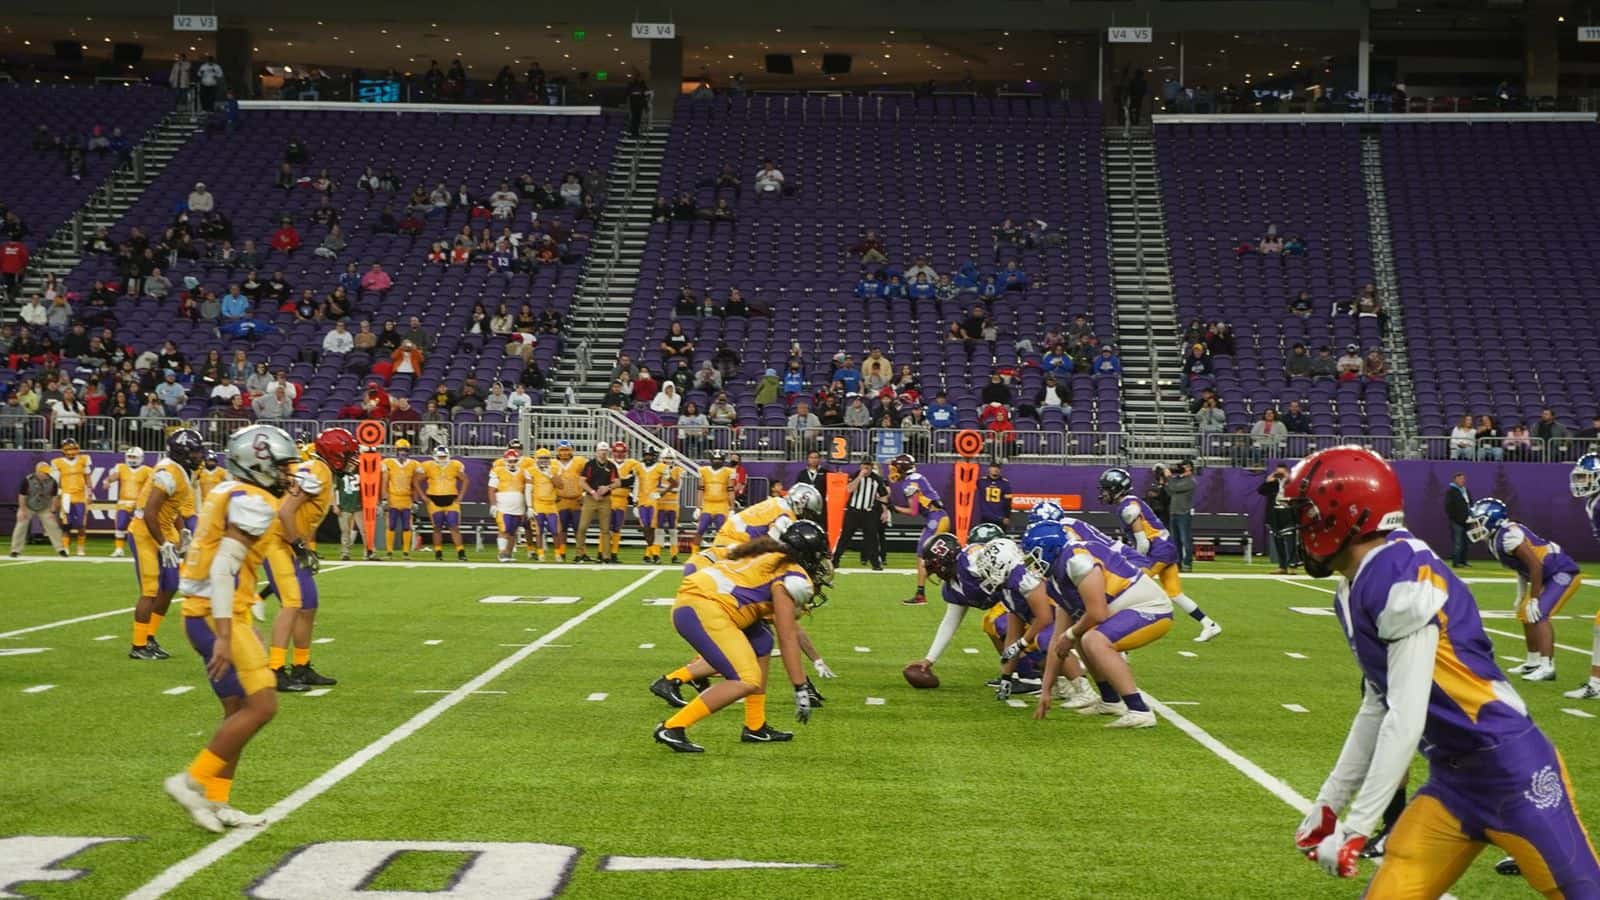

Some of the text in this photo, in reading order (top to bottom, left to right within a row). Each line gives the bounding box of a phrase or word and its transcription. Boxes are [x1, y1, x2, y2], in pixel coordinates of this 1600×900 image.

[177, 17, 214, 28] V2 V3
[635, 25, 672, 35] V3 V4
[1111, 30, 1149, 40] V4 V5
[831, 436, 848, 459] 3
[985, 486, 1001, 503] 19
